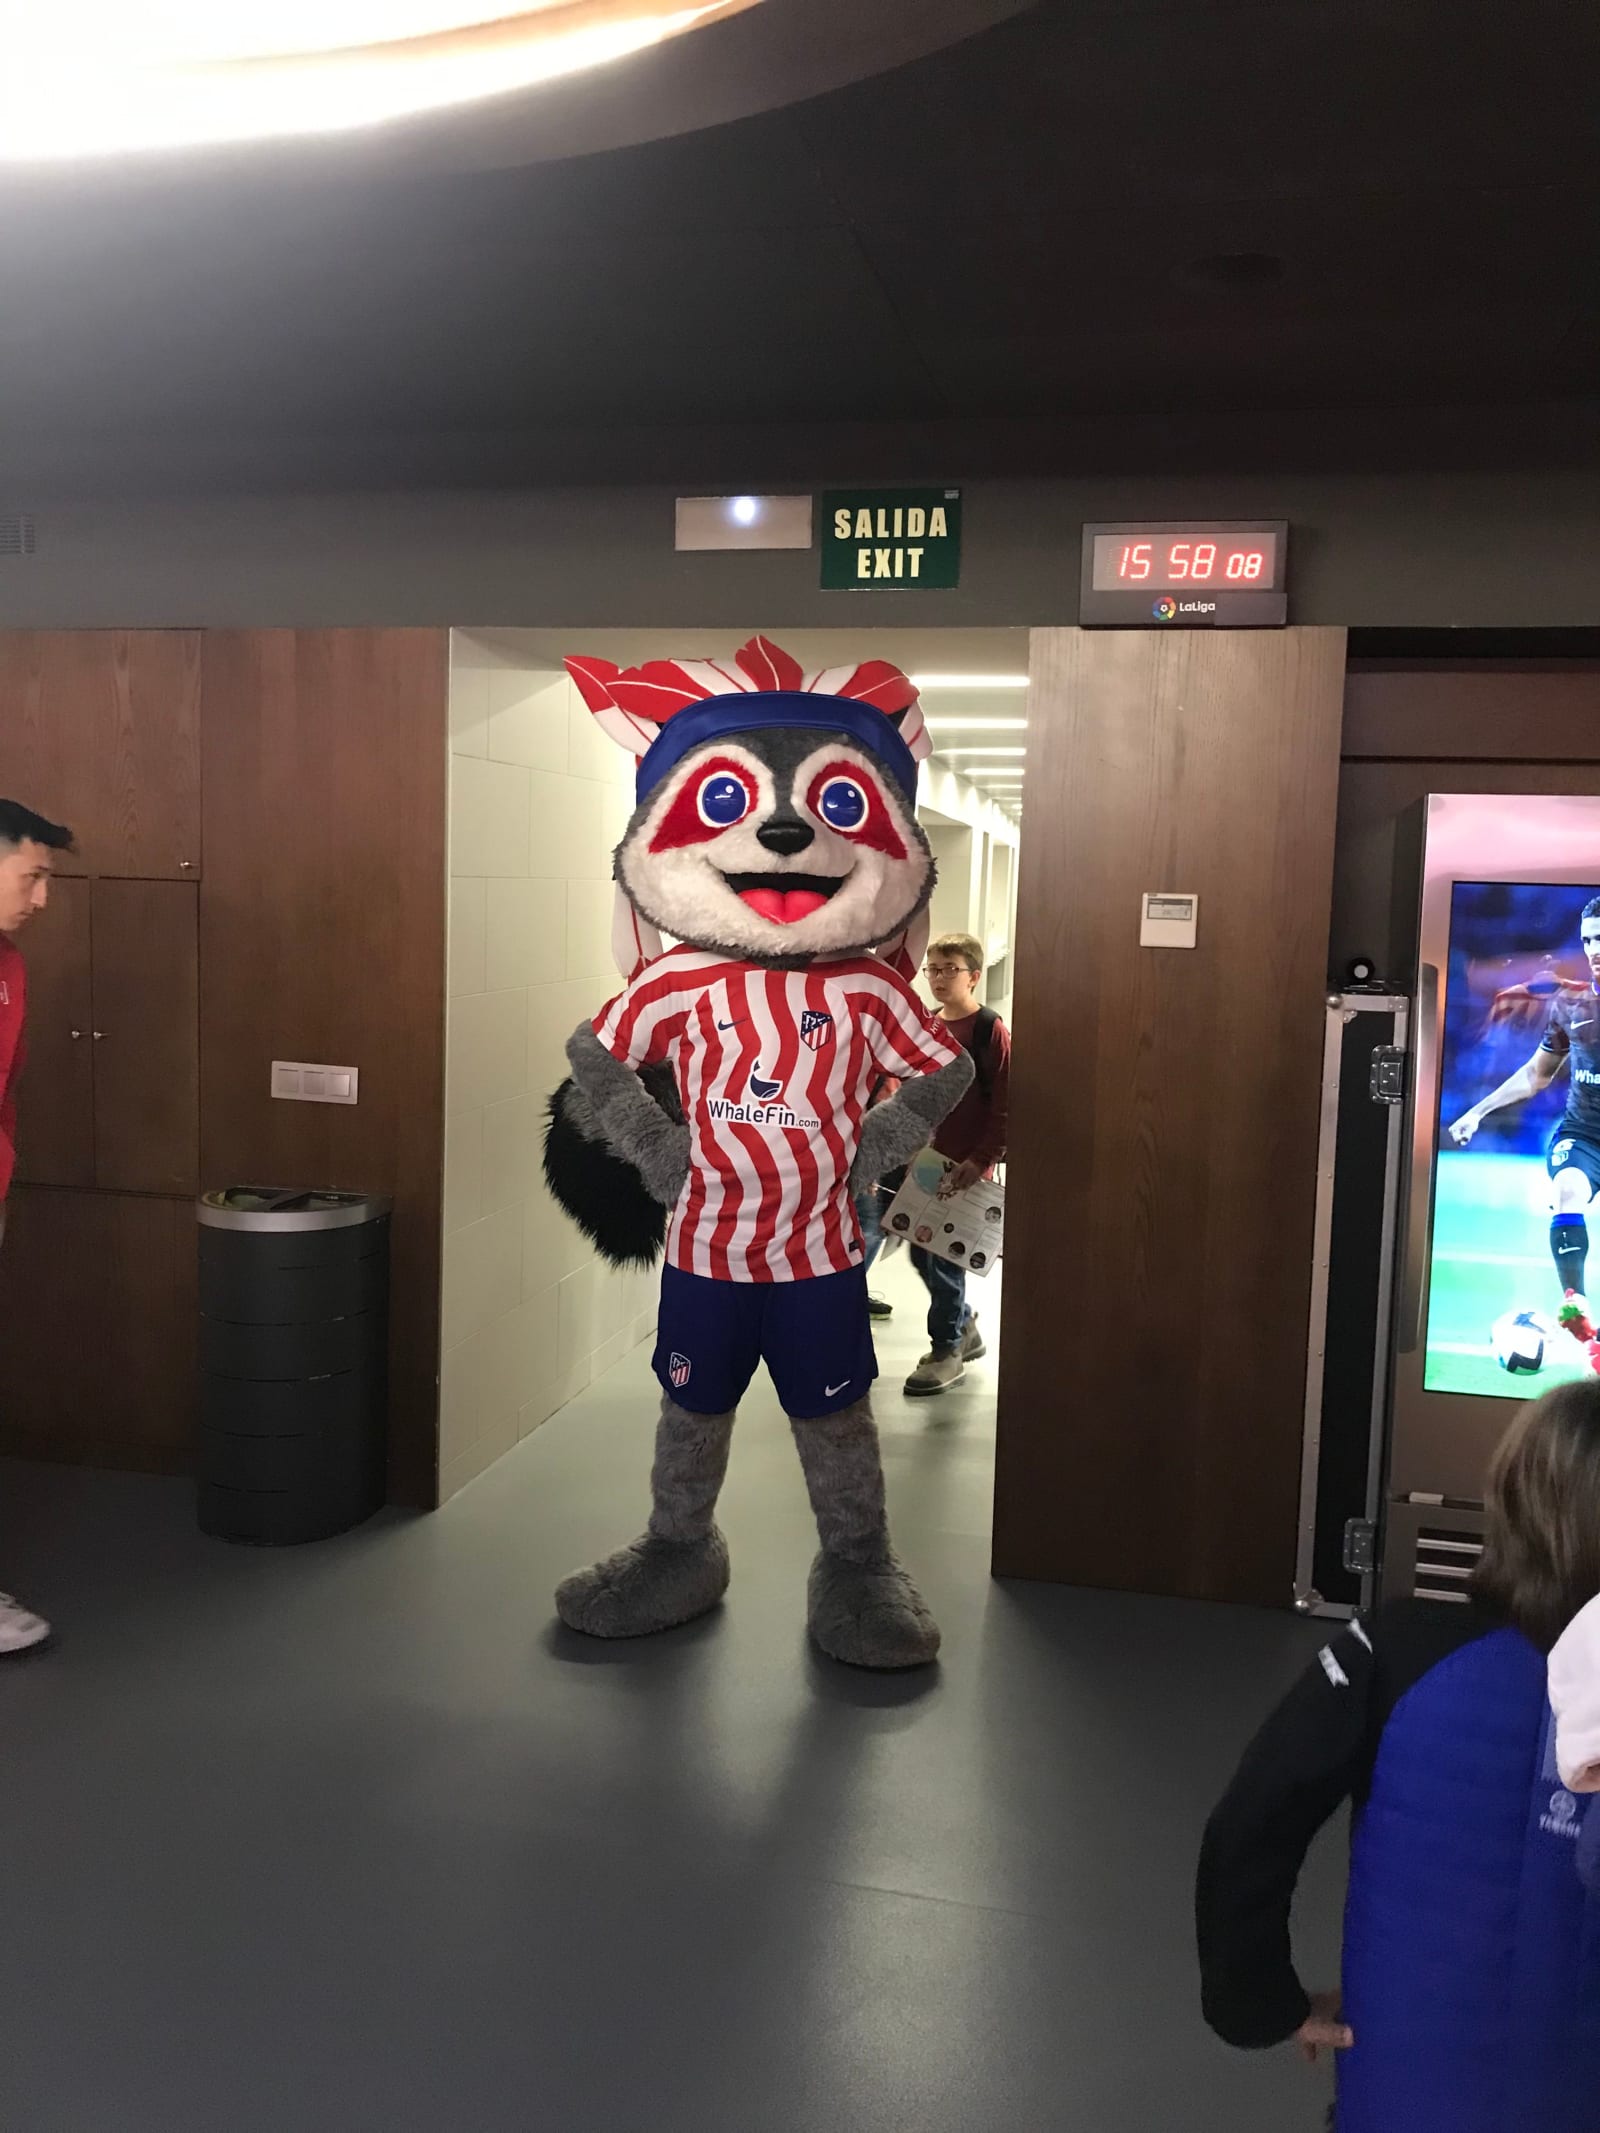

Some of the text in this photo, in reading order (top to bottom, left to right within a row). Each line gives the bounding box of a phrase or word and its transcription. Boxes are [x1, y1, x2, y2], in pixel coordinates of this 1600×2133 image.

[834, 507, 947, 539] SALIDA
[857, 547, 924, 578] EXIT
[1119, 544, 1263, 579] 15 58 08
[1179, 601, 1216, 613] LaLiga
[708, 1099, 820, 1129] WhaleFin.com
